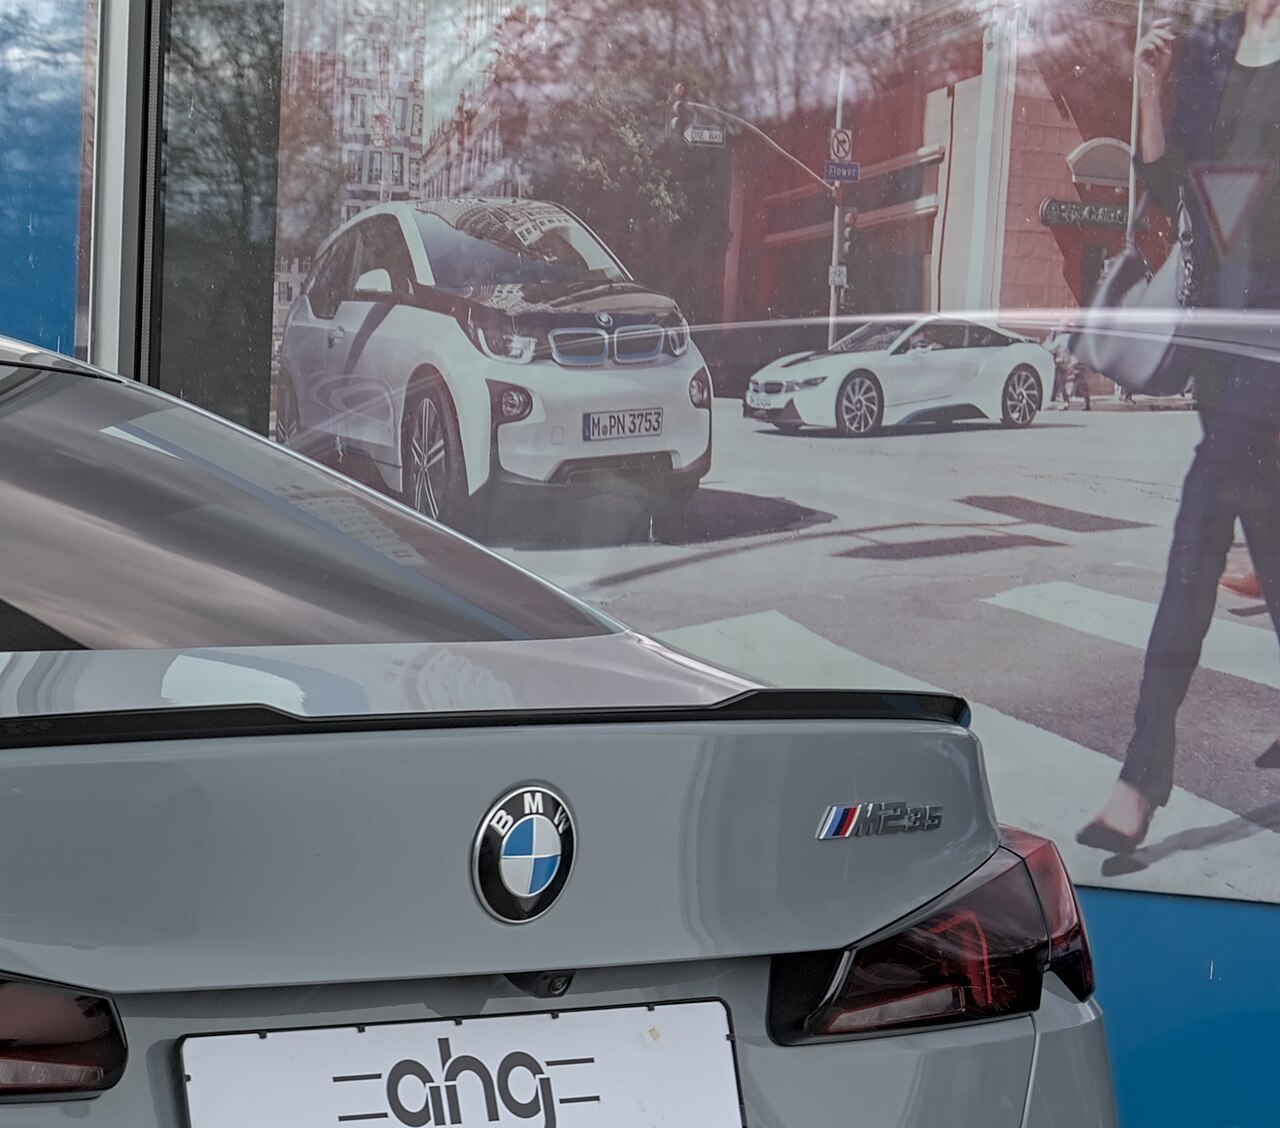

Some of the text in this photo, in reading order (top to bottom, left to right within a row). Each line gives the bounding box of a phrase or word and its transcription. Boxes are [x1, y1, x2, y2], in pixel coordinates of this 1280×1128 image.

[691, 128, 722, 141] ONE WAY
[828, 164, 857, 178] Flower
[628, 411, 662, 433] 3753
[489, 791, 571, 837] BMW
